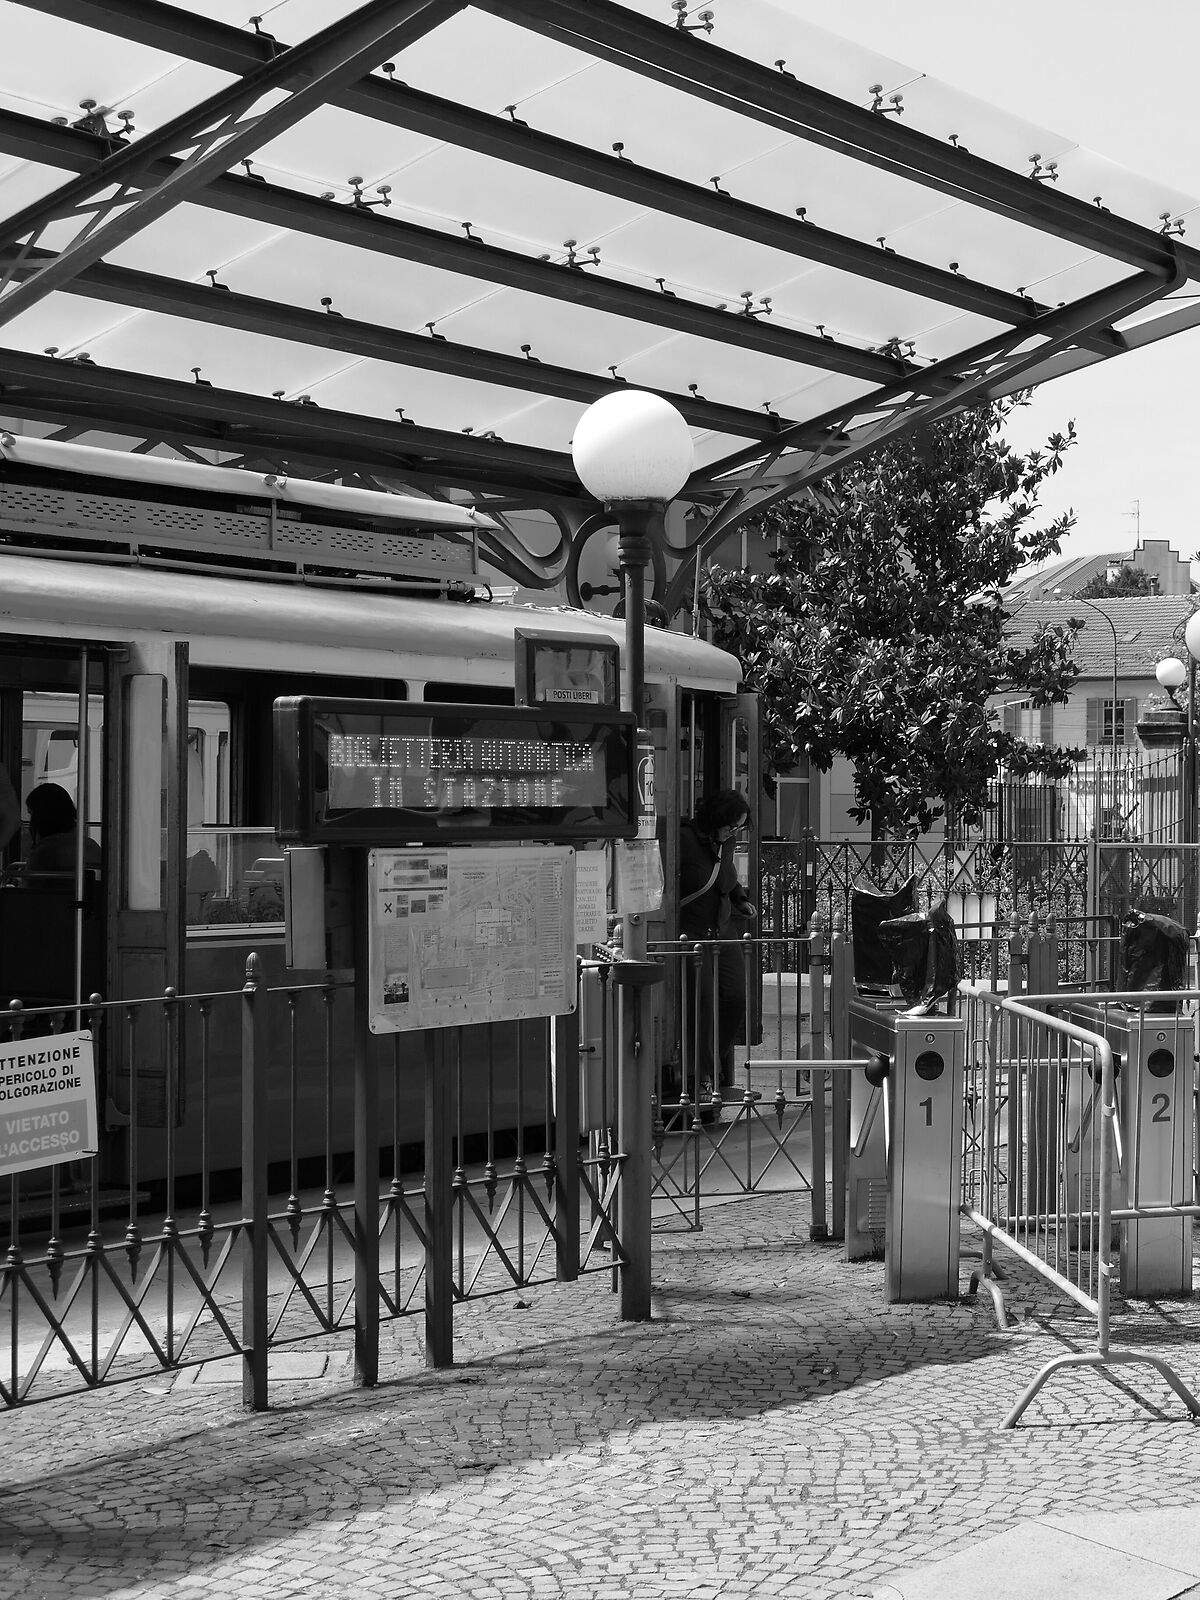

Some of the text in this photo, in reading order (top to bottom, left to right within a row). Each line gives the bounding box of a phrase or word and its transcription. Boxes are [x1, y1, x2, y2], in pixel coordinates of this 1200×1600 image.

[553, 690, 592, 700] POSTI LIBERI
[330, 735, 594, 771] BIGLIETTERIA AUTOMATICA
[371, 776, 564, 808] IN STAZIONE
[0, 1046, 81, 1071] TTENZIONE
[0, 1064, 74, 1087] PERICOLO DI
[0, 1077, 81, 1101] OLGORAZIONE
[919, 1096, 934, 1127] 1
[1151, 1093, 1171, 1123] 2
[5, 1110, 70, 1135] VIETATO
